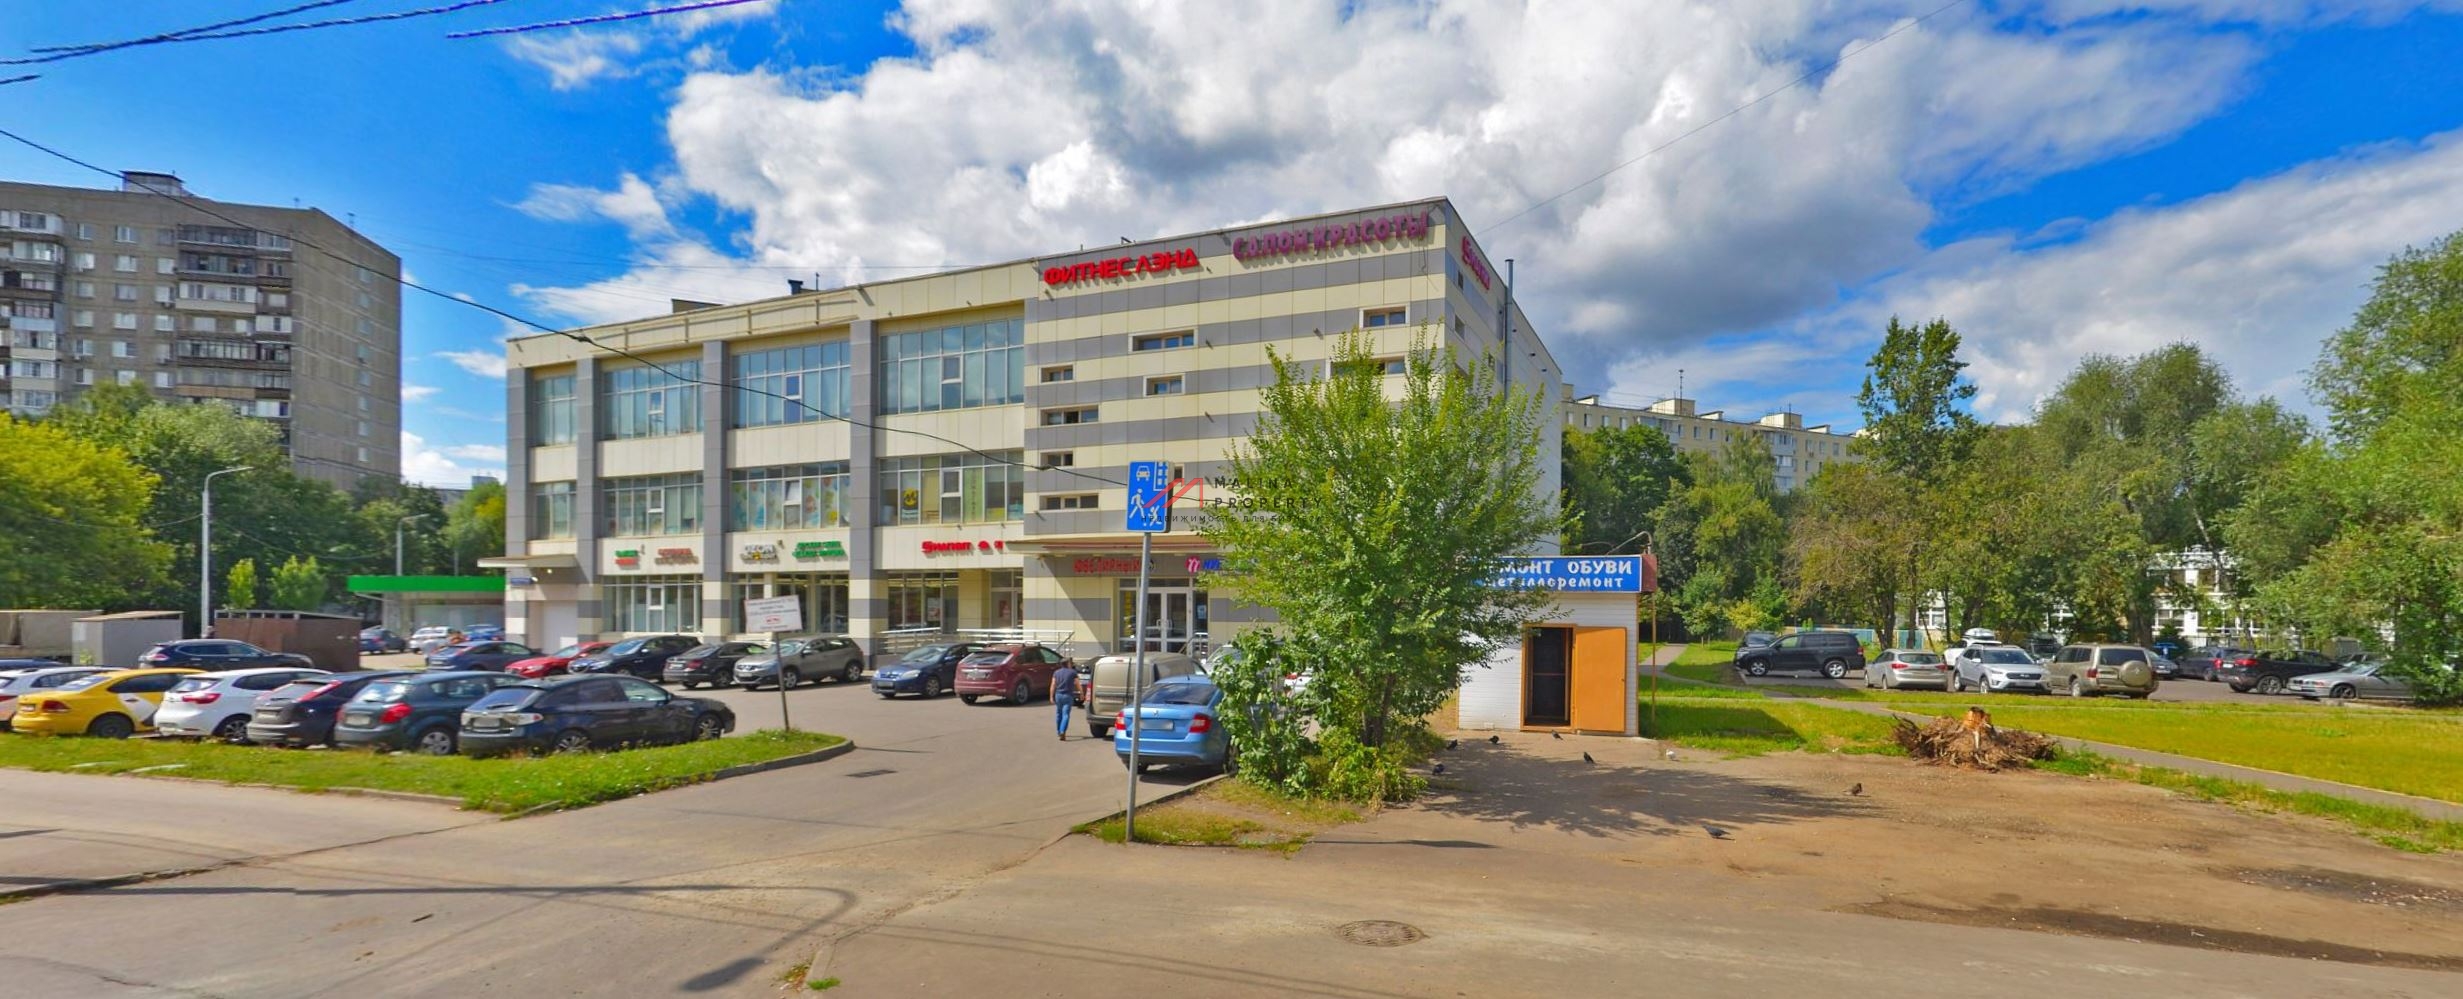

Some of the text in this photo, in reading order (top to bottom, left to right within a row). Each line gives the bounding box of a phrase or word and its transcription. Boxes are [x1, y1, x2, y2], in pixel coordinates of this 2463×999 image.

[1232, 211, 1428, 261] САЛОН КРАСОТЫ
[1043, 247, 1200, 285] ФИТНЕС ЛЭНД
[1567, 559, 1633, 575] ОБУВИ
